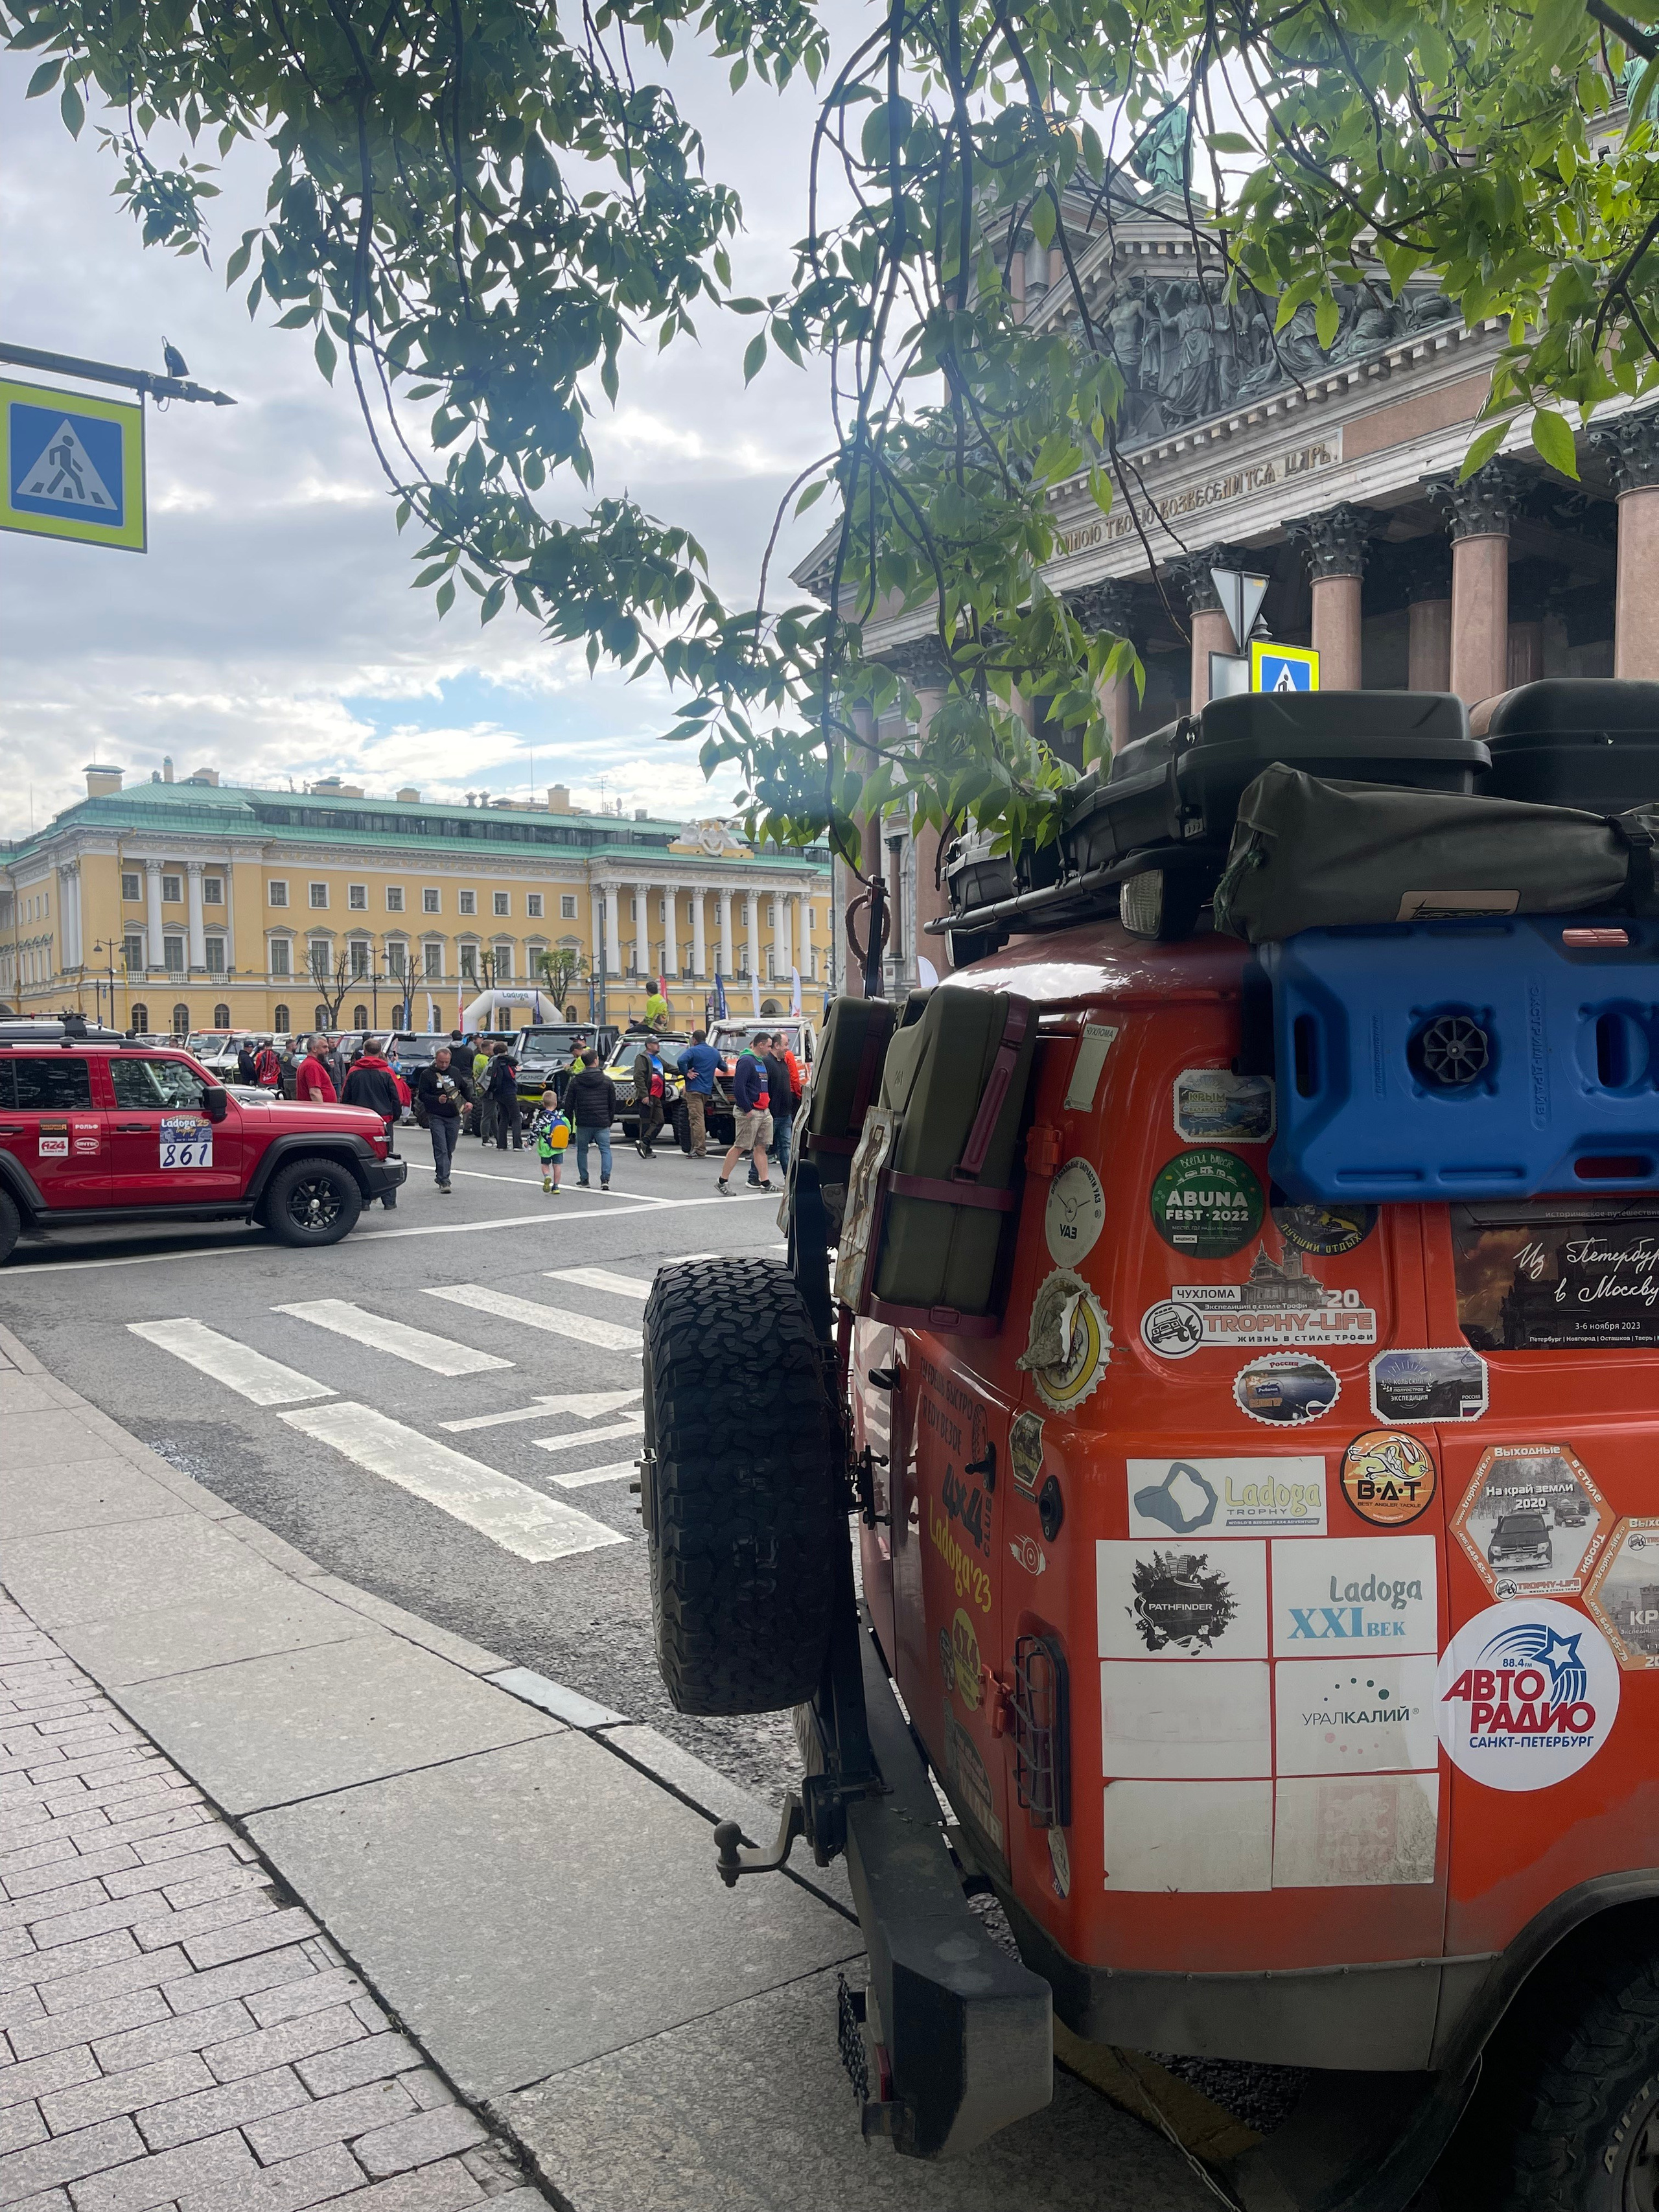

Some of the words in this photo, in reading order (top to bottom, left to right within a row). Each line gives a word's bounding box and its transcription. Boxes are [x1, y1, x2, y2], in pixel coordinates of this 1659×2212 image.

[1086, 1027, 1114, 1038] ЧУХЛОМА
[1189, 1092, 1225, 1102] КРЫМ
[162, 1145, 208, 1167] 861
[1166, 1191, 1248, 1207] ABUNA
[1166, 1209, 1203, 1221] FEST
[1212, 1210, 1249, 1222] 2022
[1060, 1224, 1078, 1240] УАЗ
[1513, 1242, 1546, 1279] Из
[1176, 1289, 1236, 1299] ЧУХЛОМА
[1554, 1277, 1567, 1302] в
[1578, 1274, 1659, 1306] Москву
[1203, 1312, 1373, 1332] TROPHY-LIFE
[1590, 1321, 1619, 1331] ноября
[1494, 1446, 1561, 1457] Выходные
[1225, 1475, 1322, 1517] Ladoga
[1456, 1455, 1491, 1526] www.trophy-life.ru
[1486, 1486, 1502, 1496] На
[1504, 1483, 1533, 1496] край
[1535, 1484, 1574, 1493] земли
[1515, 1498, 1547, 1508] 2020
[982, 1496, 993, 1558] CLUB
[1457, 1530, 1470, 1548] (495)
[1467, 1545, 1493, 1585] 649-65-79
[1580, 1533, 1606, 1574] Трофи
[1589, 1525, 1626, 1596] www.trophy-life.ru
[1329, 1574, 1423, 1611] Ladoga
[1516, 1579, 1580, 1590] TROPHY-LIFE
[1148, 1603, 1213, 1611] PATHFINDER
[1287, 1607, 1365, 1639] XXI
[1367, 1621, 1406, 1636] ВЕК
[1588, 1598, 1601, 1619] (495)
[1599, 1616, 1629, 1662] 649-65-79
[1441, 1669, 1546, 1702] АВТО
[1470, 1701, 1596, 1734] РАДИО
[1469, 1736, 1594, 1748] САНКТ-ПЕТЕРБУРГ
[1052, 1878, 1062, 1896] RU
